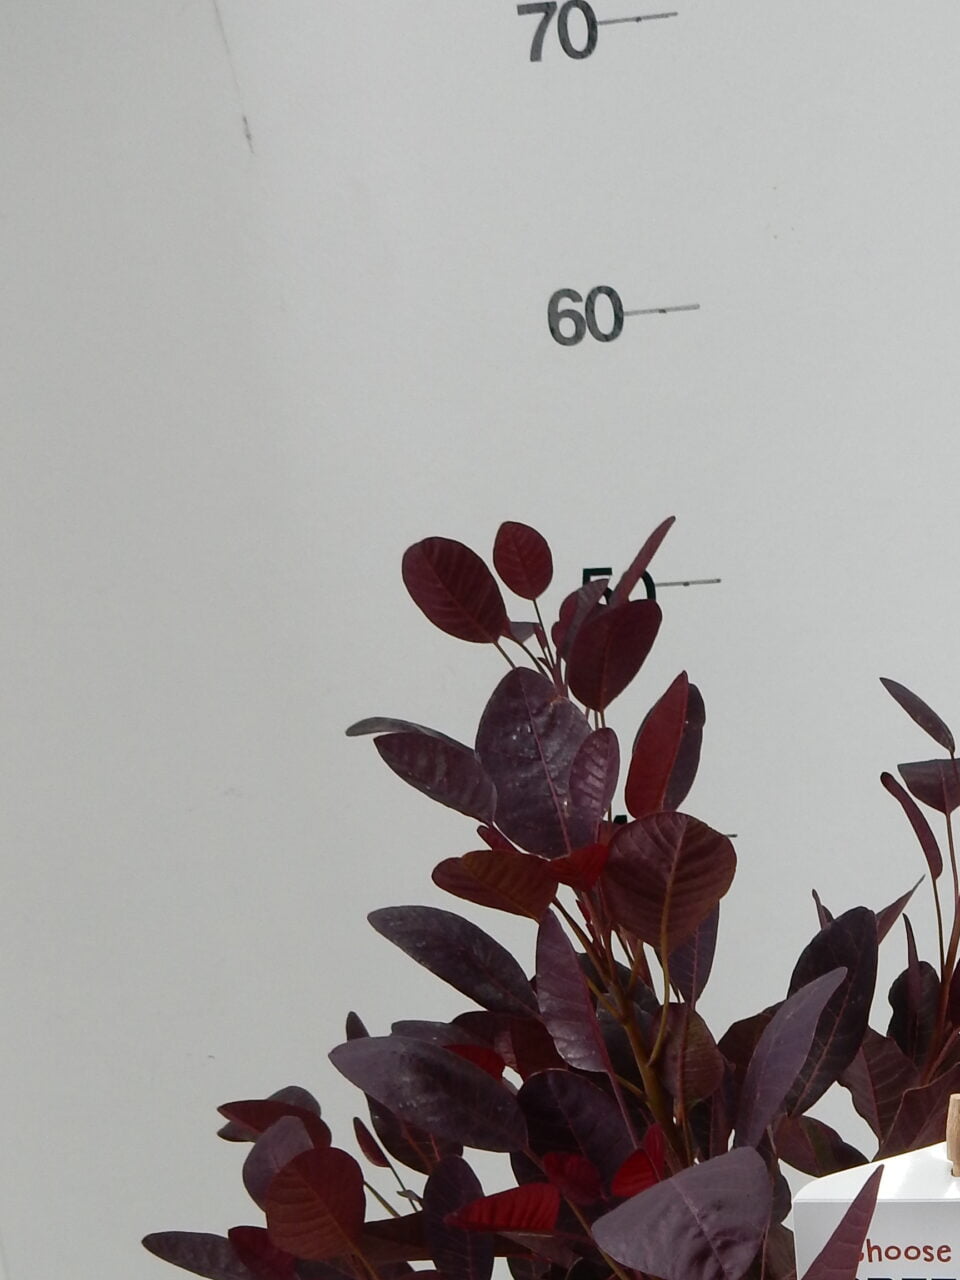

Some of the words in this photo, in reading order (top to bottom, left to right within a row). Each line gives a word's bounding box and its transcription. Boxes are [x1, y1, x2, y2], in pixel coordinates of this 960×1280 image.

[516, 0, 598, 62] 70
[547, 285, 624, 346] 60
[857, 1238, 952, 1263] hoose
